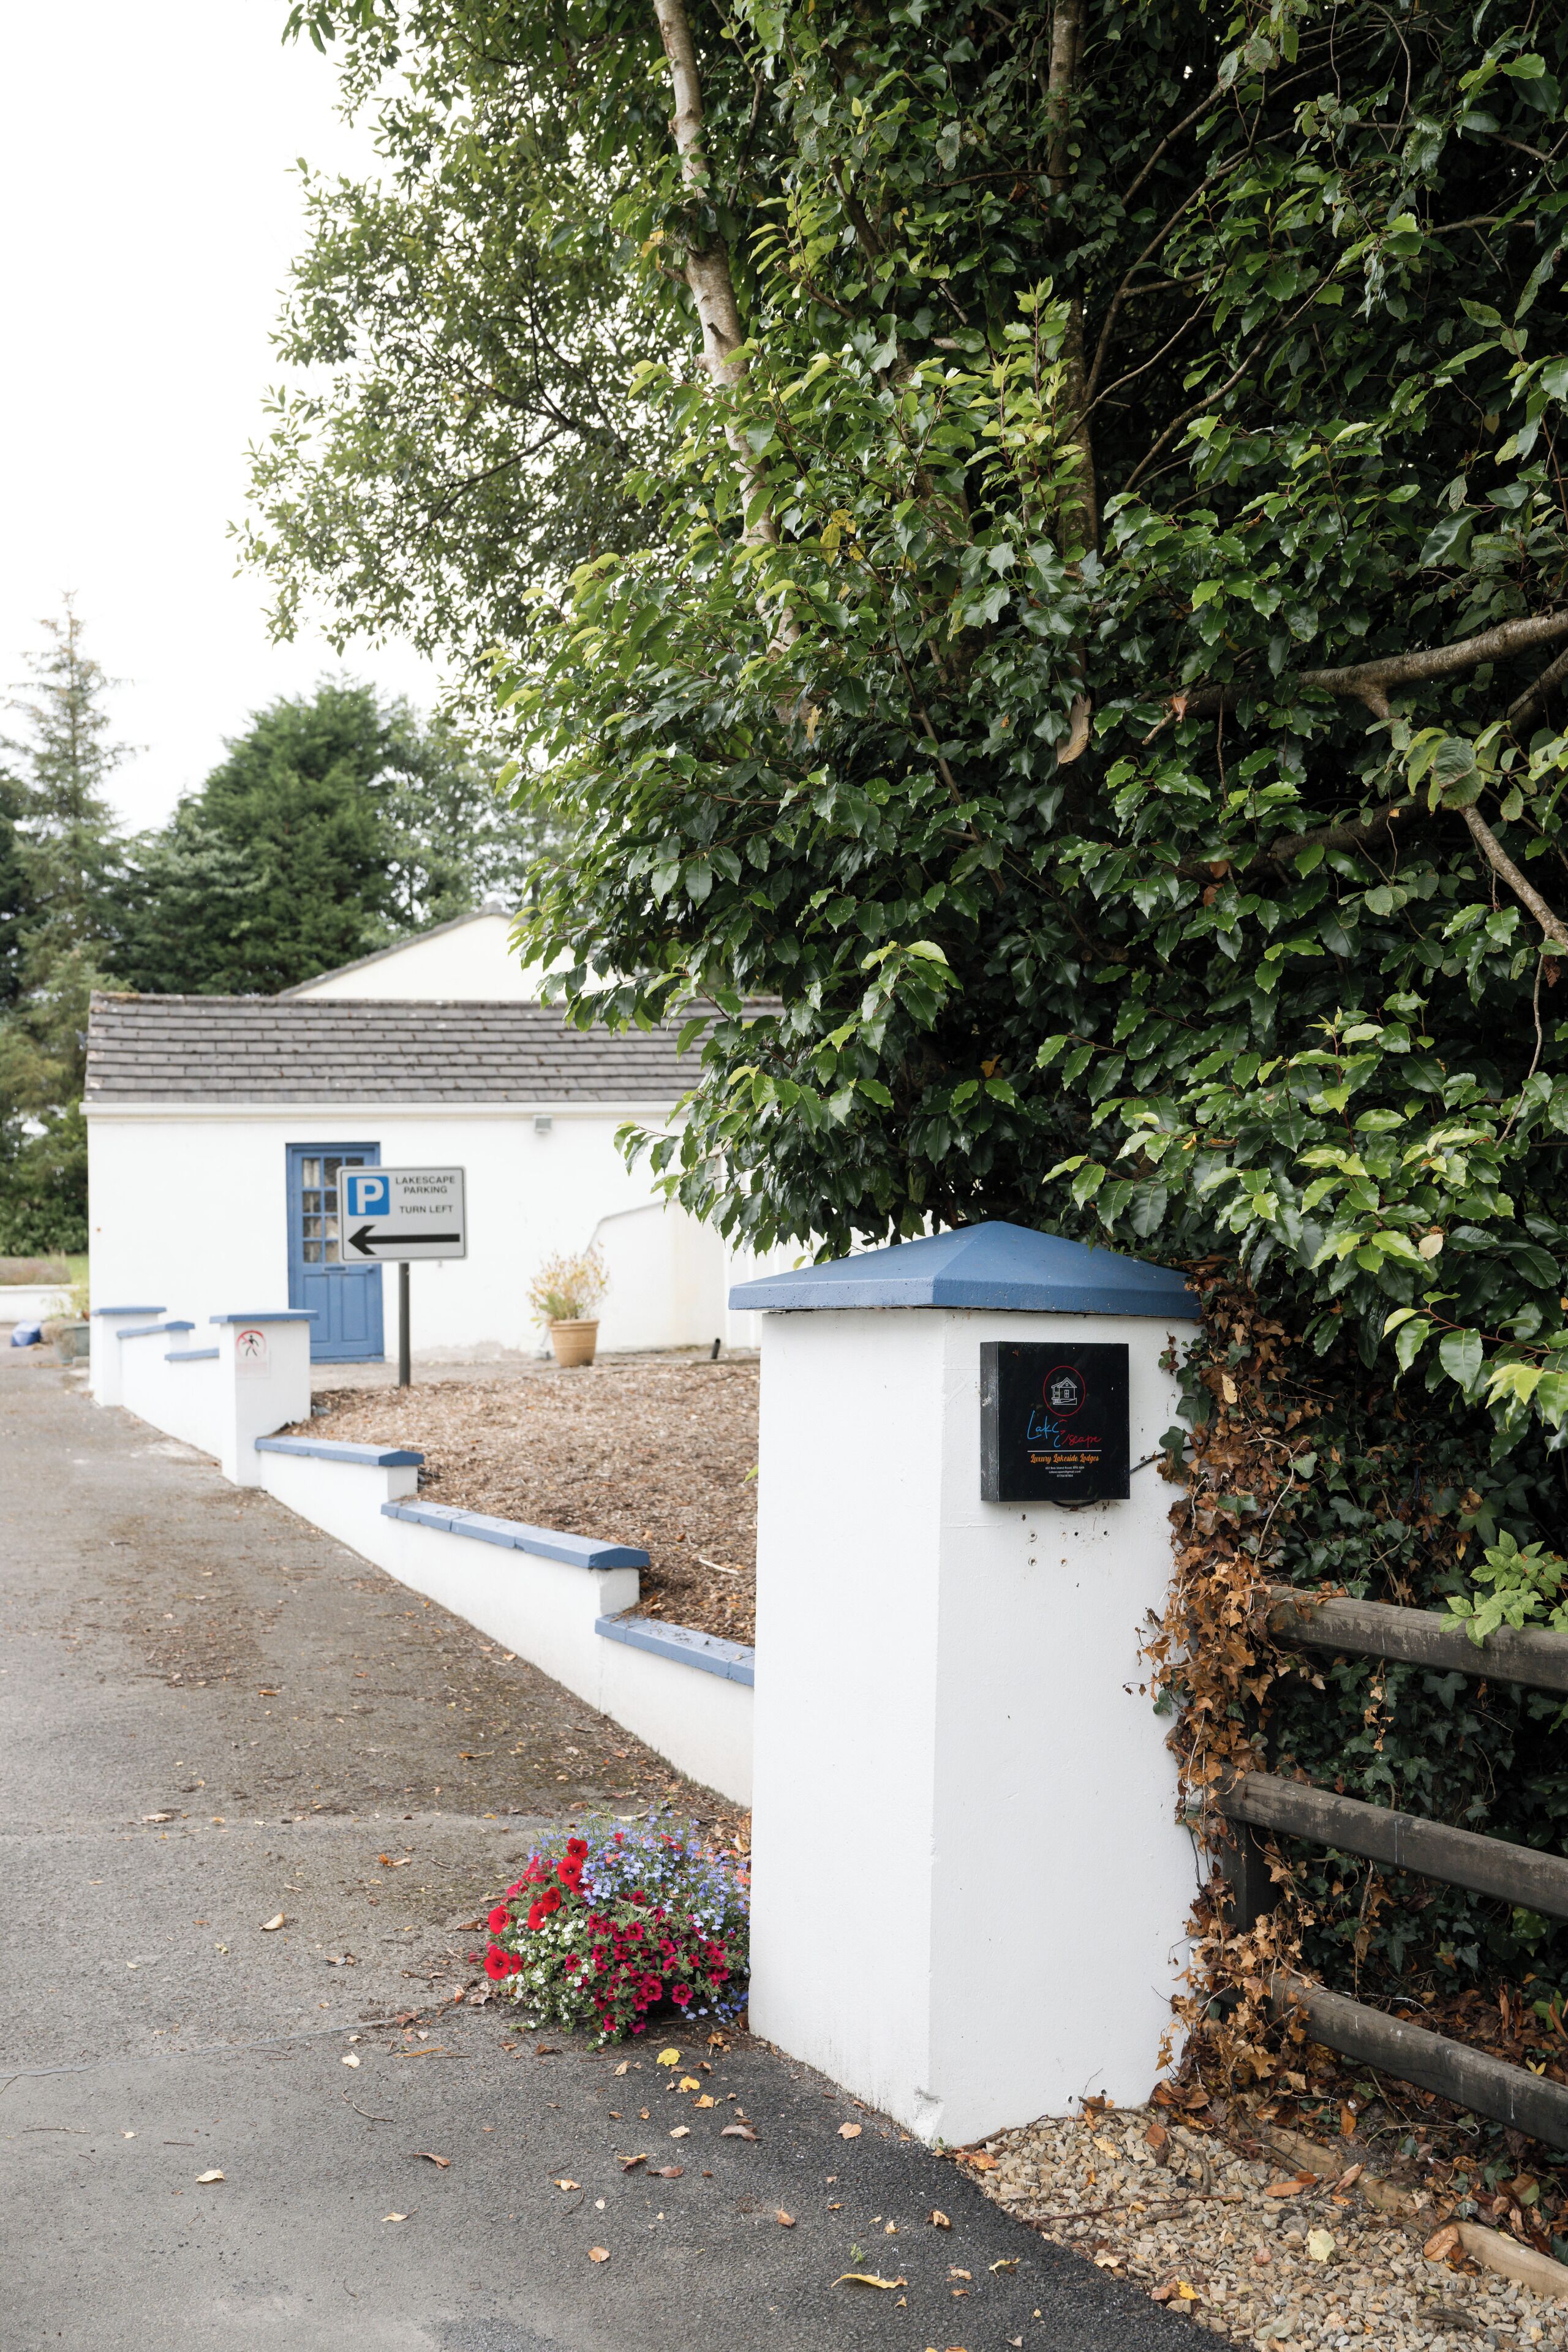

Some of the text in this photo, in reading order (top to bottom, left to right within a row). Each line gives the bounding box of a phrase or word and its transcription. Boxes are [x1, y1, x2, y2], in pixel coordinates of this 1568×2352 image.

[395, 1175, 456, 1185] LAKESCAPE
[404, 1185, 448, 1194] PARKING
[356, 1177, 384, 1215] P
[399, 1205, 426, 1214] TURN
[1030, 1453, 1099, 1464] Luxury Lakeside Lodges
